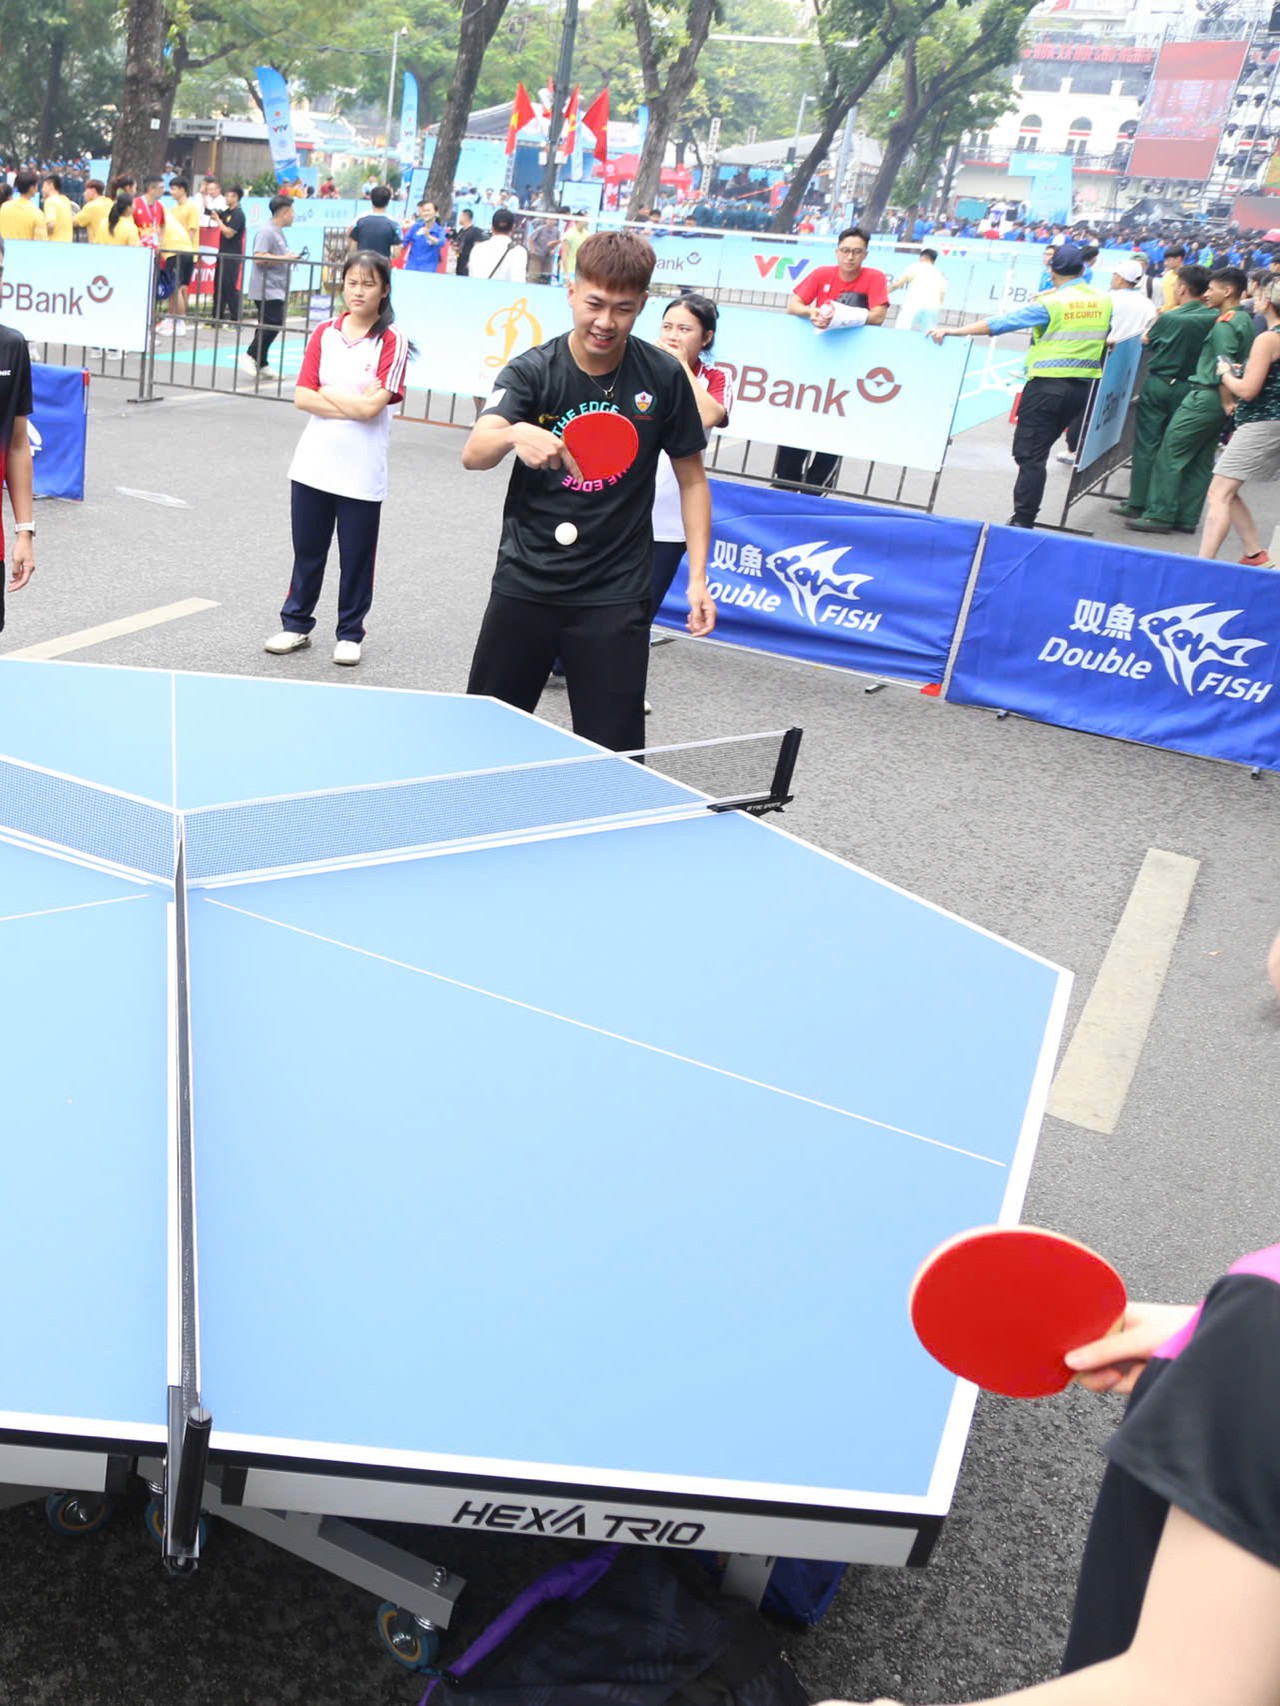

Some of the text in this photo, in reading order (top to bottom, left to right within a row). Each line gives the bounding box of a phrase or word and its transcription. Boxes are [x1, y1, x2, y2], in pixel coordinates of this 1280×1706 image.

[753, 254, 810, 281] VTV
[1063, 311, 1103, 321] SECURITY
[552, 401, 620, 437] THE EDGE
[704, 575, 781, 612] ouble
[819, 602, 882, 633] FISH
[1038, 637, 1152, 681] Double
[1197, 671, 1274, 704] FISH
[451, 1500, 706, 1546] HEXA TRIO
